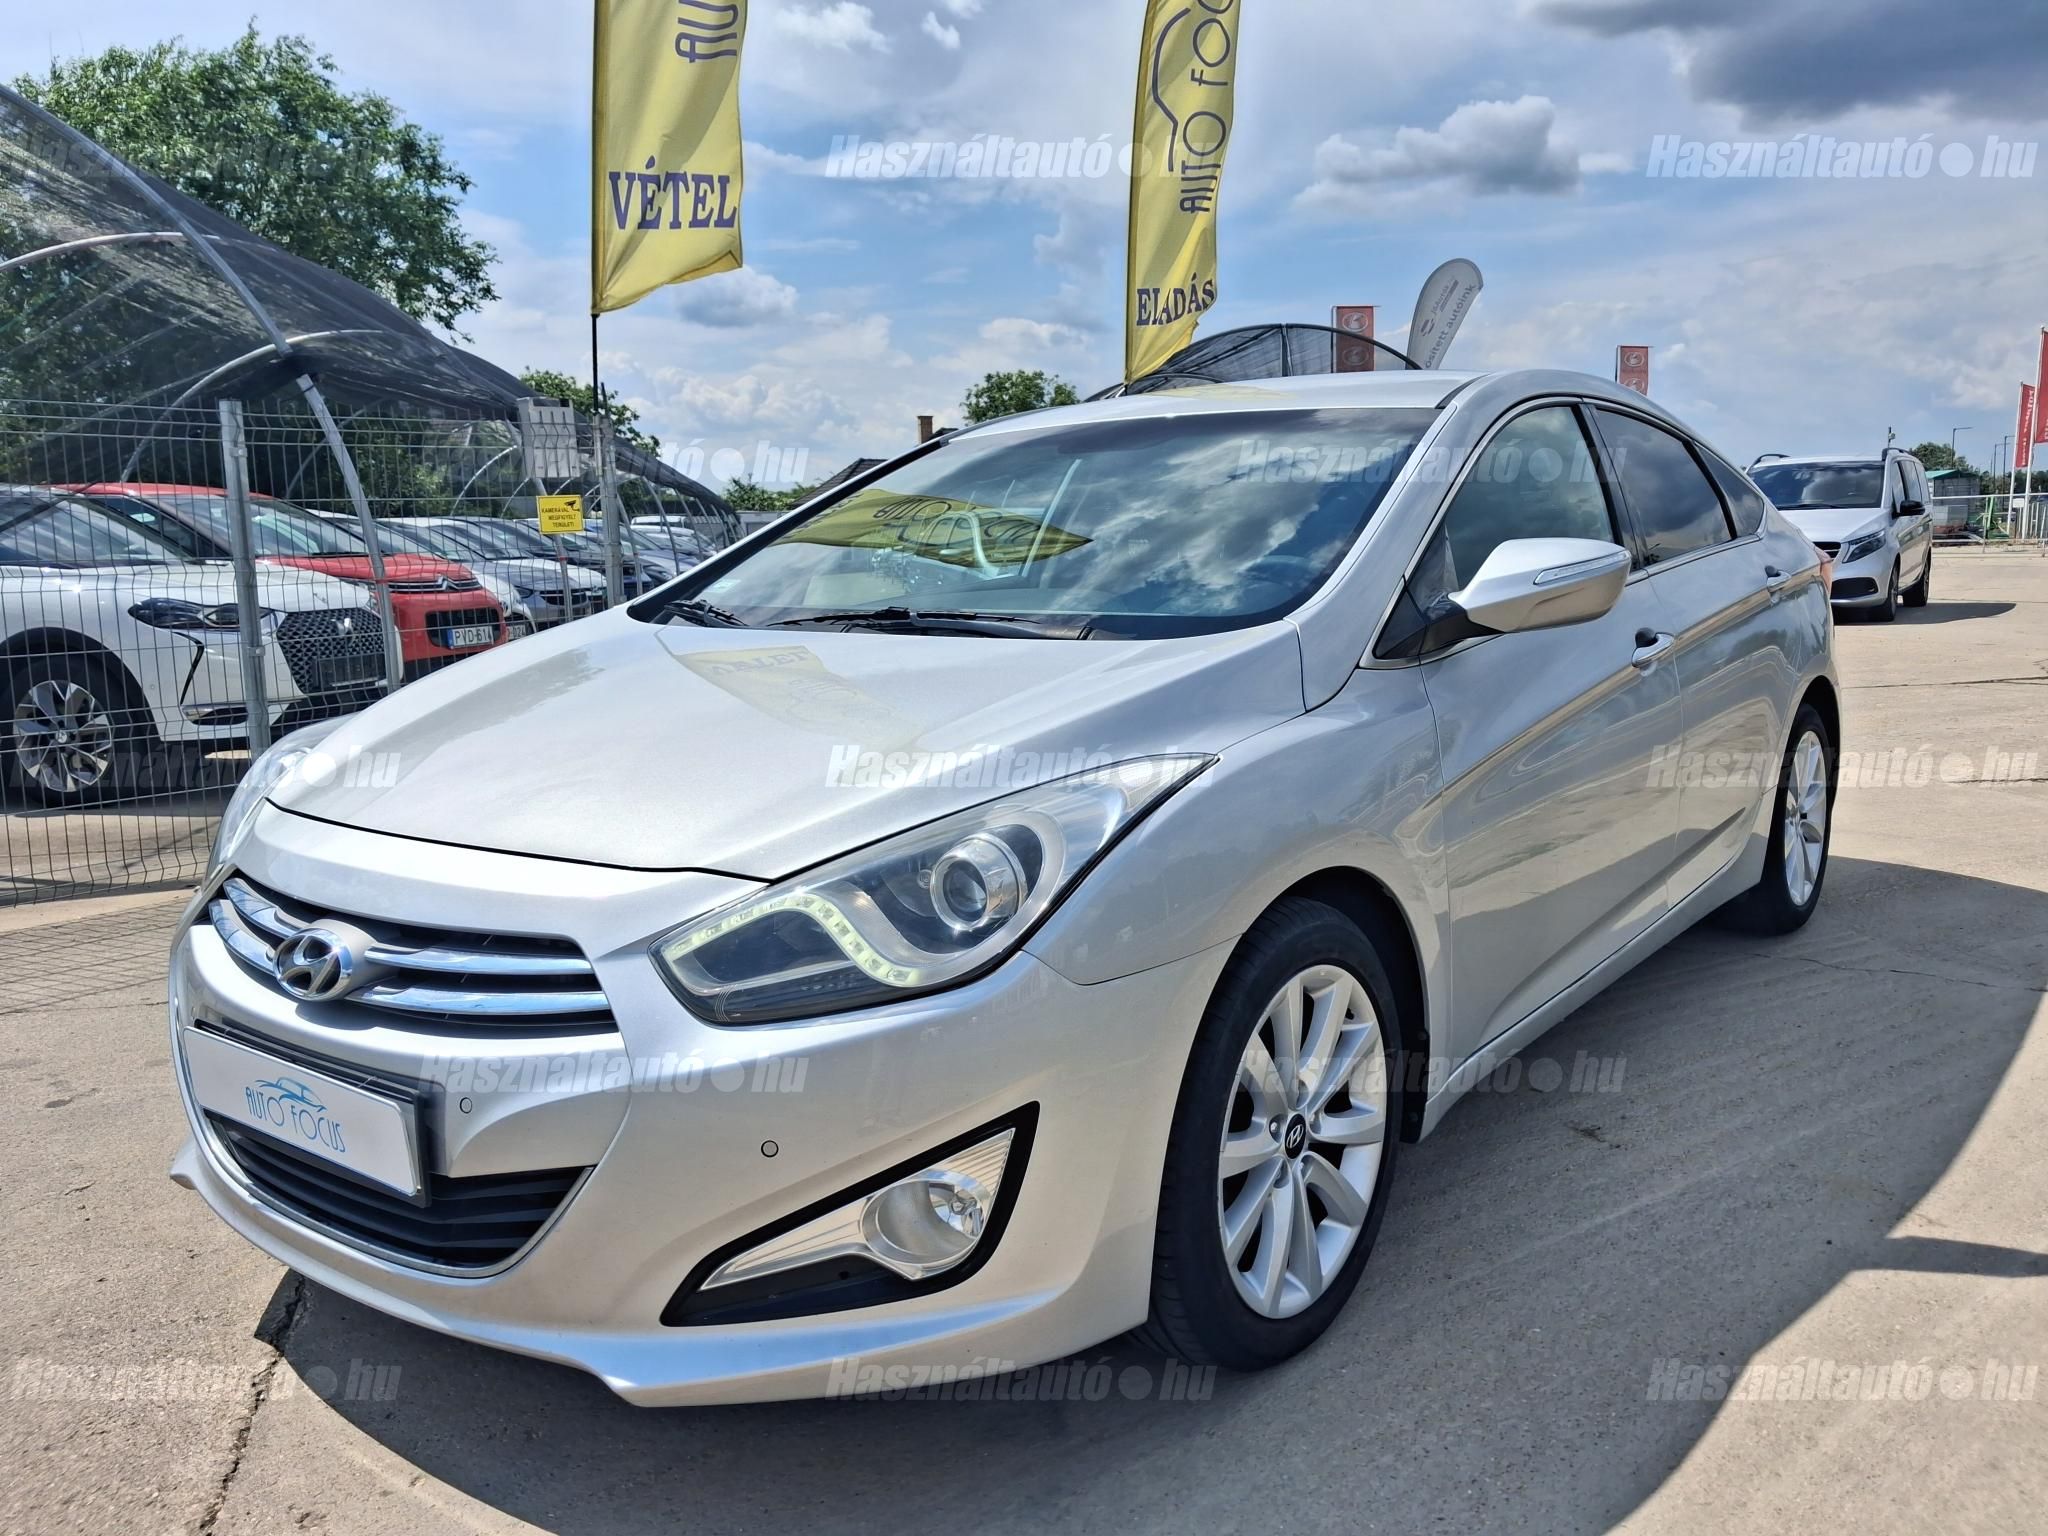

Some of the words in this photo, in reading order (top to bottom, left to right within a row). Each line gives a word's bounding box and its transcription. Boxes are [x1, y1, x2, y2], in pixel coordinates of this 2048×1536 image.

[608, 155, 737, 230] VÉTEL
[1179, 111, 1227, 213] AUTO
[1136, 272, 1215, 326] ELADÁS
[245, 1086, 285, 1127] AUTO
[290, 1105, 346, 1153] FOCUS
